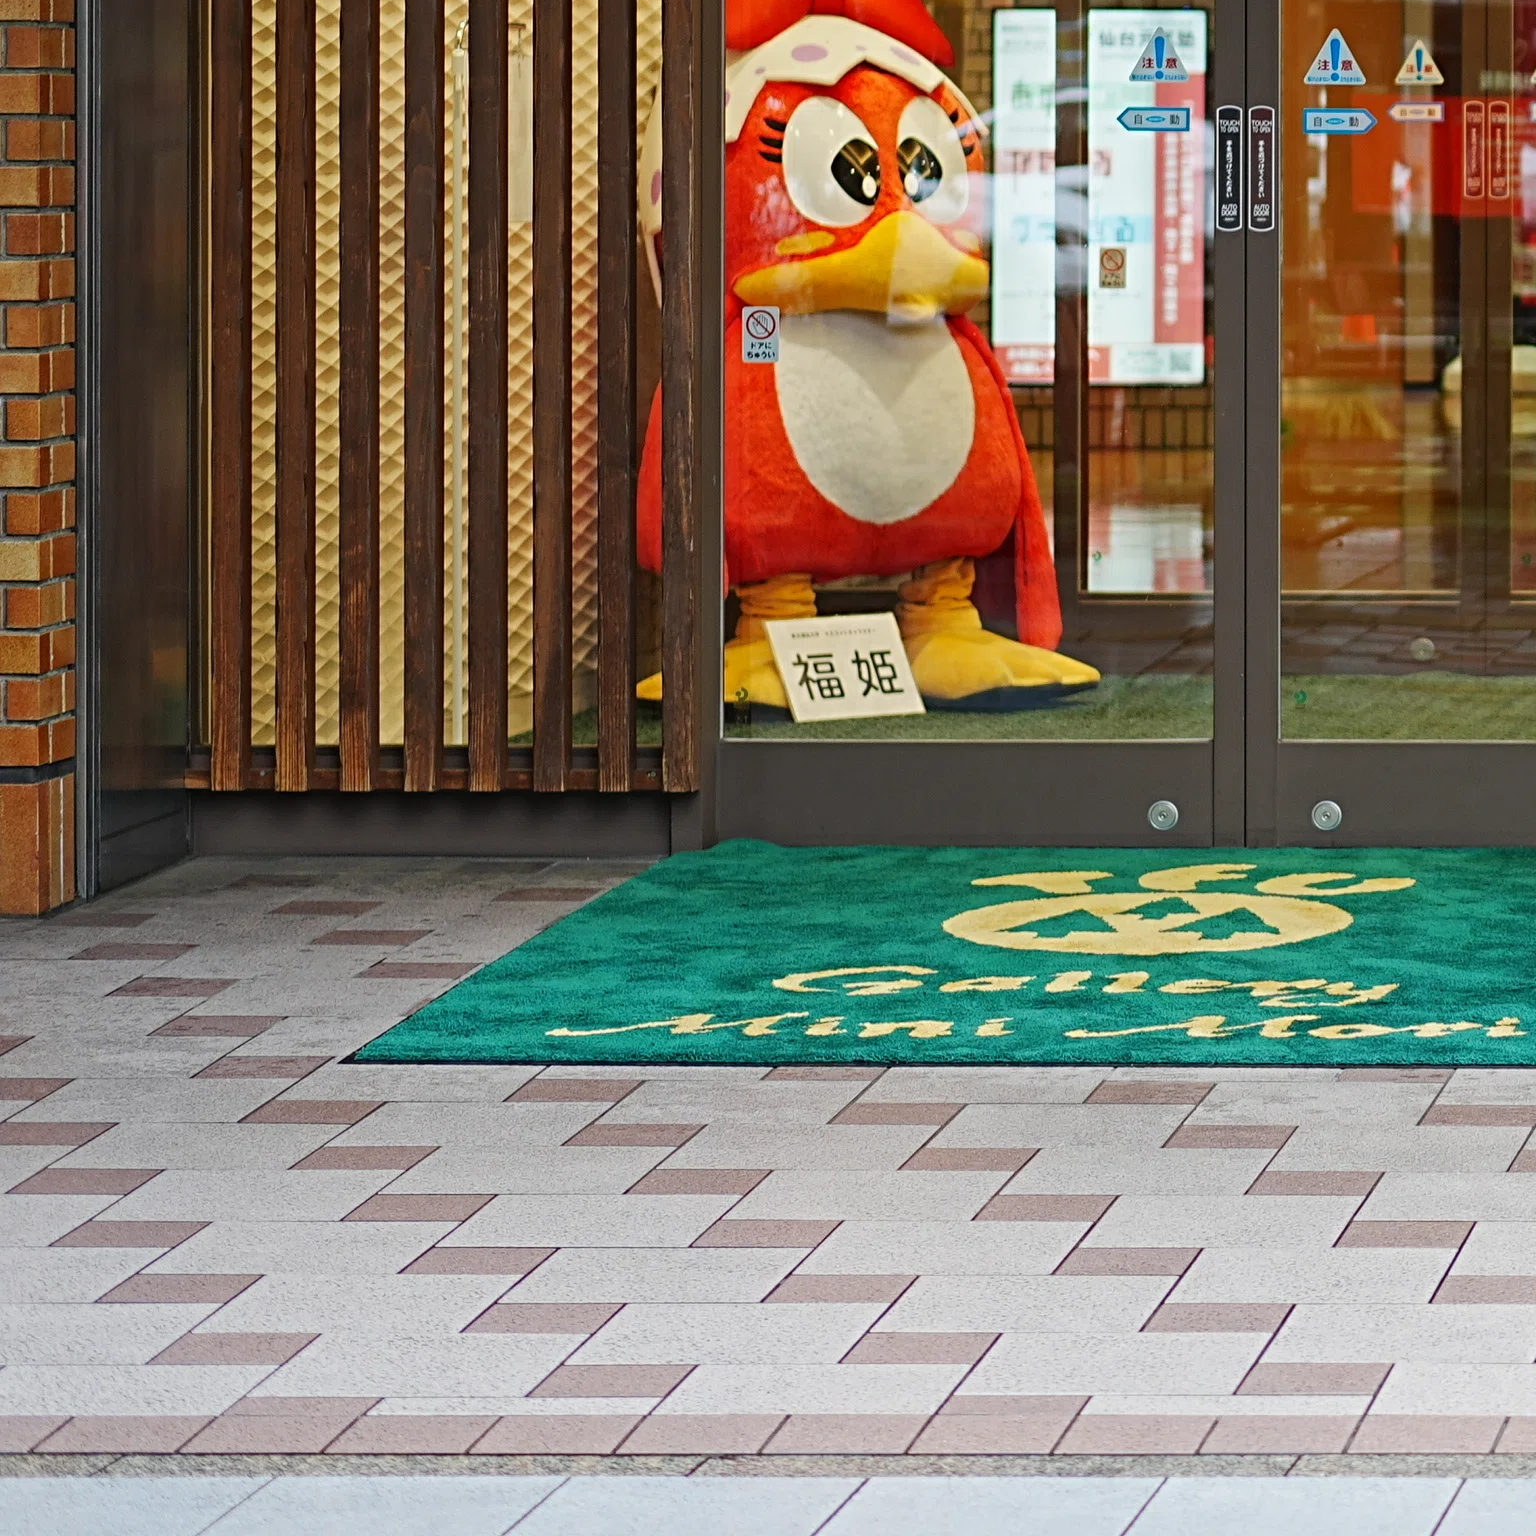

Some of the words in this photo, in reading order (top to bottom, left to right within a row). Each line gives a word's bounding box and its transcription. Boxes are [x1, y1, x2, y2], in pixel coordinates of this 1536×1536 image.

[792, 649, 904, 701] 福姫
[772, 965, 1402, 1008] Gallery
[545, 1011, 1016, 1039] Mini
[1064, 1013, 1529, 1040] Mori
